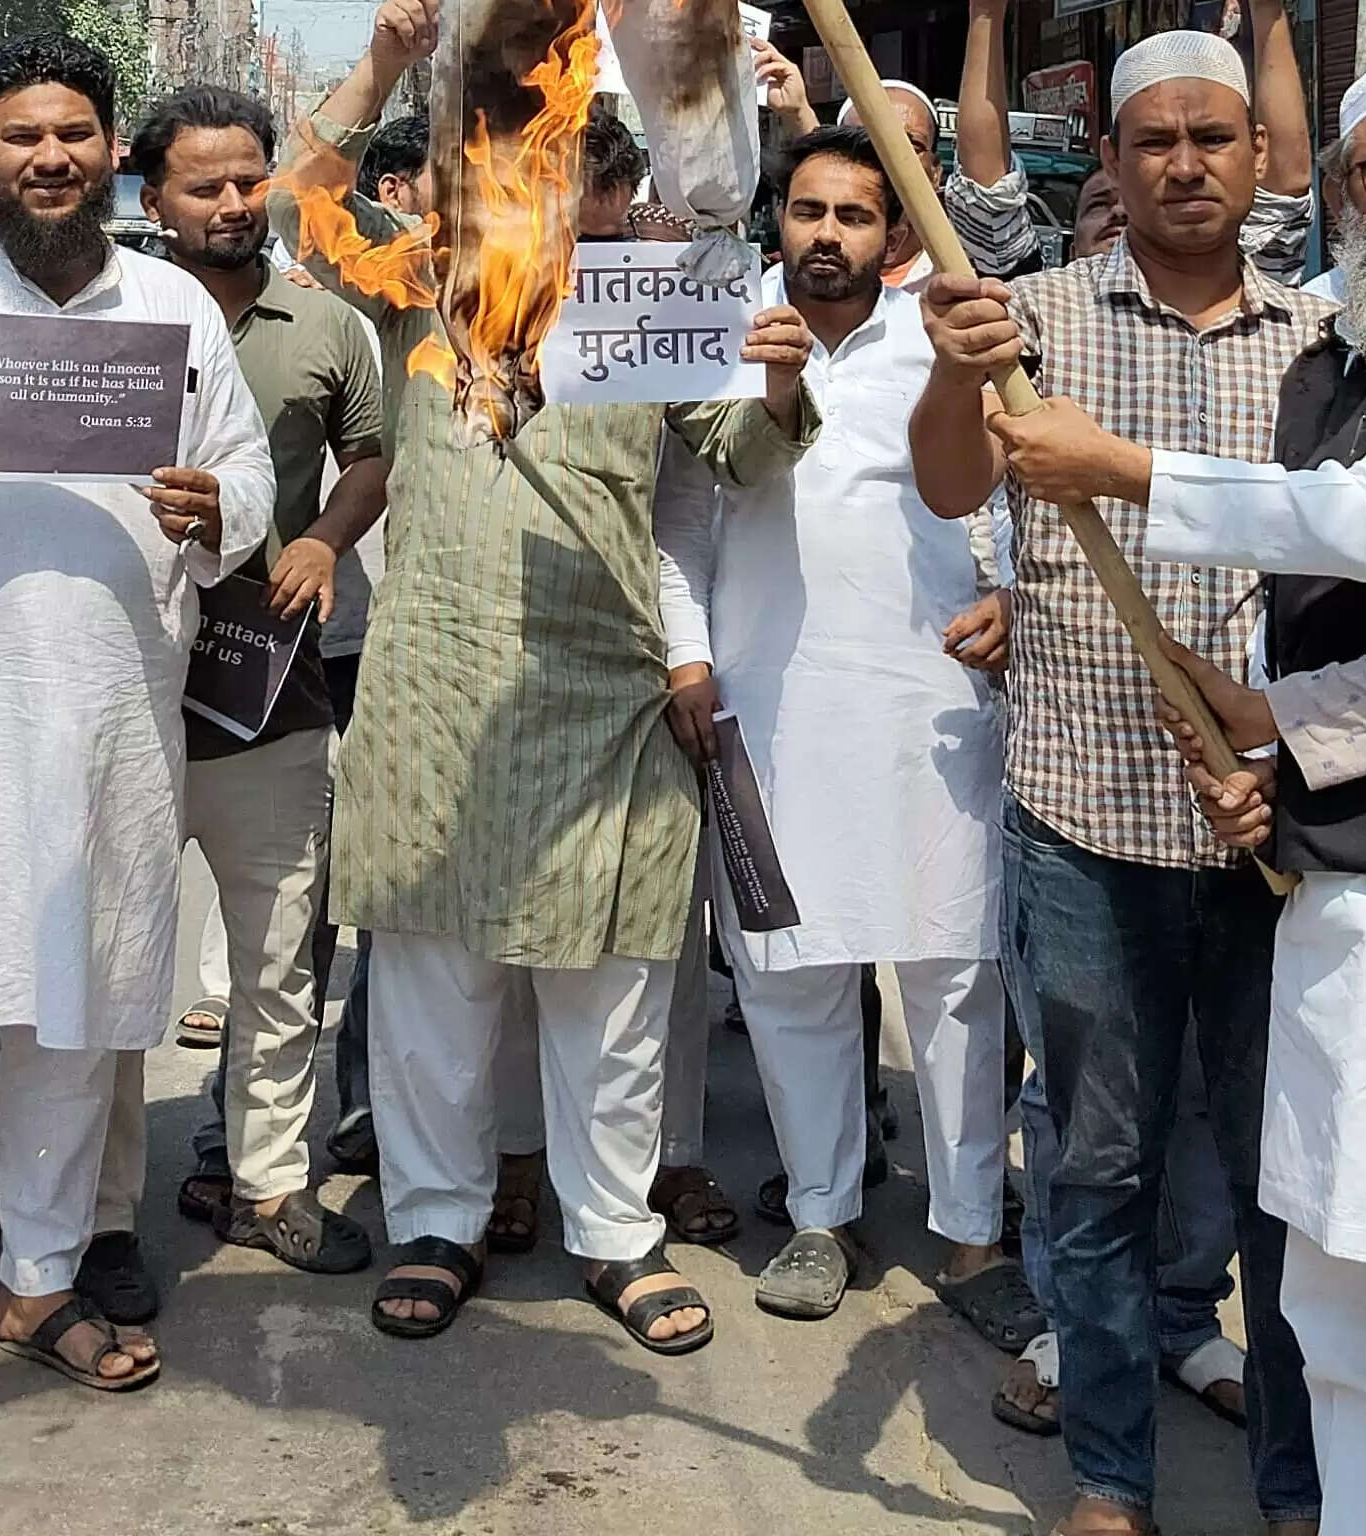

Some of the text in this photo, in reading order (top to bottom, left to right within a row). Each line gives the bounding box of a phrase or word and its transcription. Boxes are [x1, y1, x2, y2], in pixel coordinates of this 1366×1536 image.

[573, 315, 729, 382] मुर्दाबाद
[51, 359, 80, 373] kills
[82, 364, 100, 374] an
[103, 362, 162, 376] innocent
[23, 374, 35, 386] it
[38, 375, 50, 386] is
[51, 378, 66, 387] as
[69, 376, 80, 388] if
[82, 376, 99, 389] he
[101, 377, 125, 390] has
[127, 377, 164, 391] killed
[10, 388, 27, 400] all
[31, 389, 46, 401] of
[80, 415, 152, 428] Quran 5:32
[213, 620, 279, 654] attack
[193, 639, 243, 665] of us
